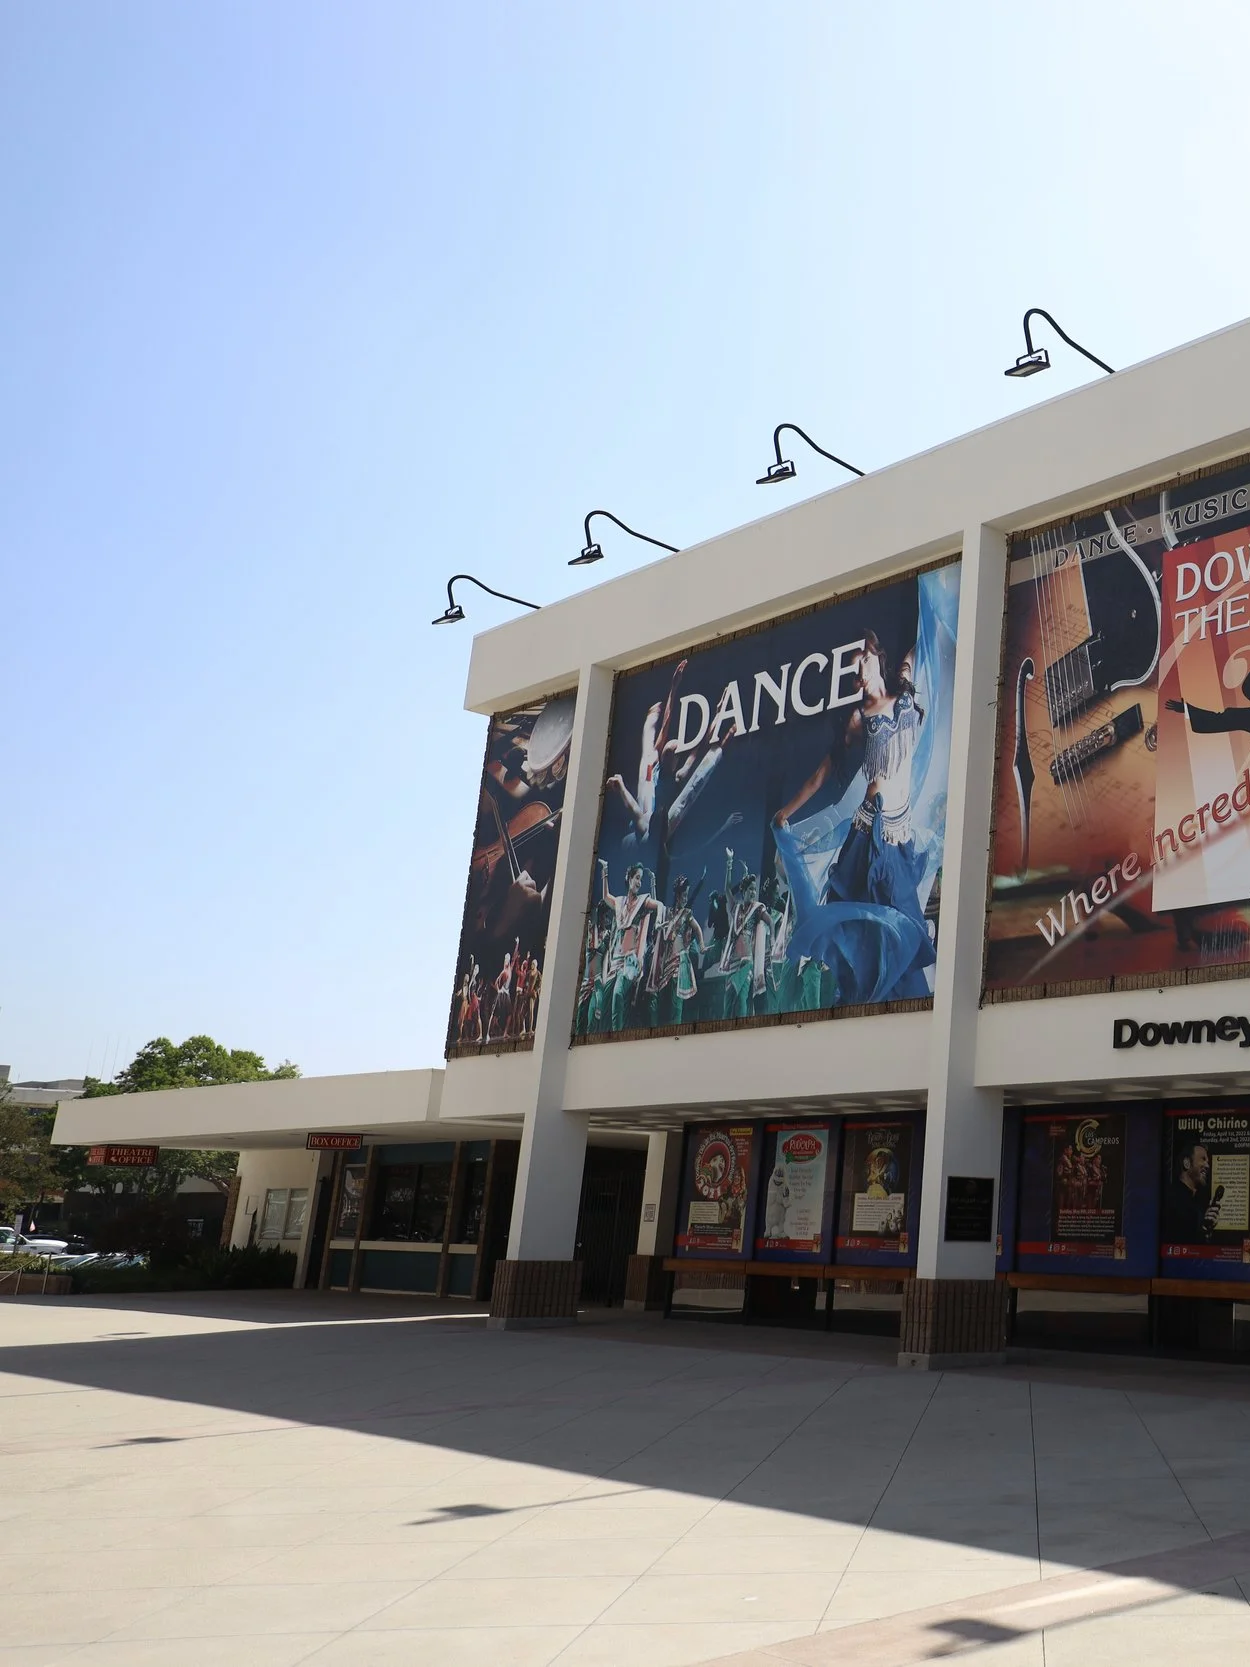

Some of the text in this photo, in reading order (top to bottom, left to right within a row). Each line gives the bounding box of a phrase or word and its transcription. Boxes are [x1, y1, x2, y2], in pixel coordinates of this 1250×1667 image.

[1054, 524, 1138, 570] DANCE
[1163, 488, 1249, 533] MUSIC
[674, 638, 866, 754] DANCE
[1035, 852, 1142, 947] Where
[1178, 1117, 1248, 1133] Willy Chirino
[311, 1137, 361, 1147] BOX OFFICE
[1087, 1137, 1120, 1145] CAMPEROS
[111, 1148, 155, 1156] THEATRE
[118, 1156, 153, 1164] OFFICE
